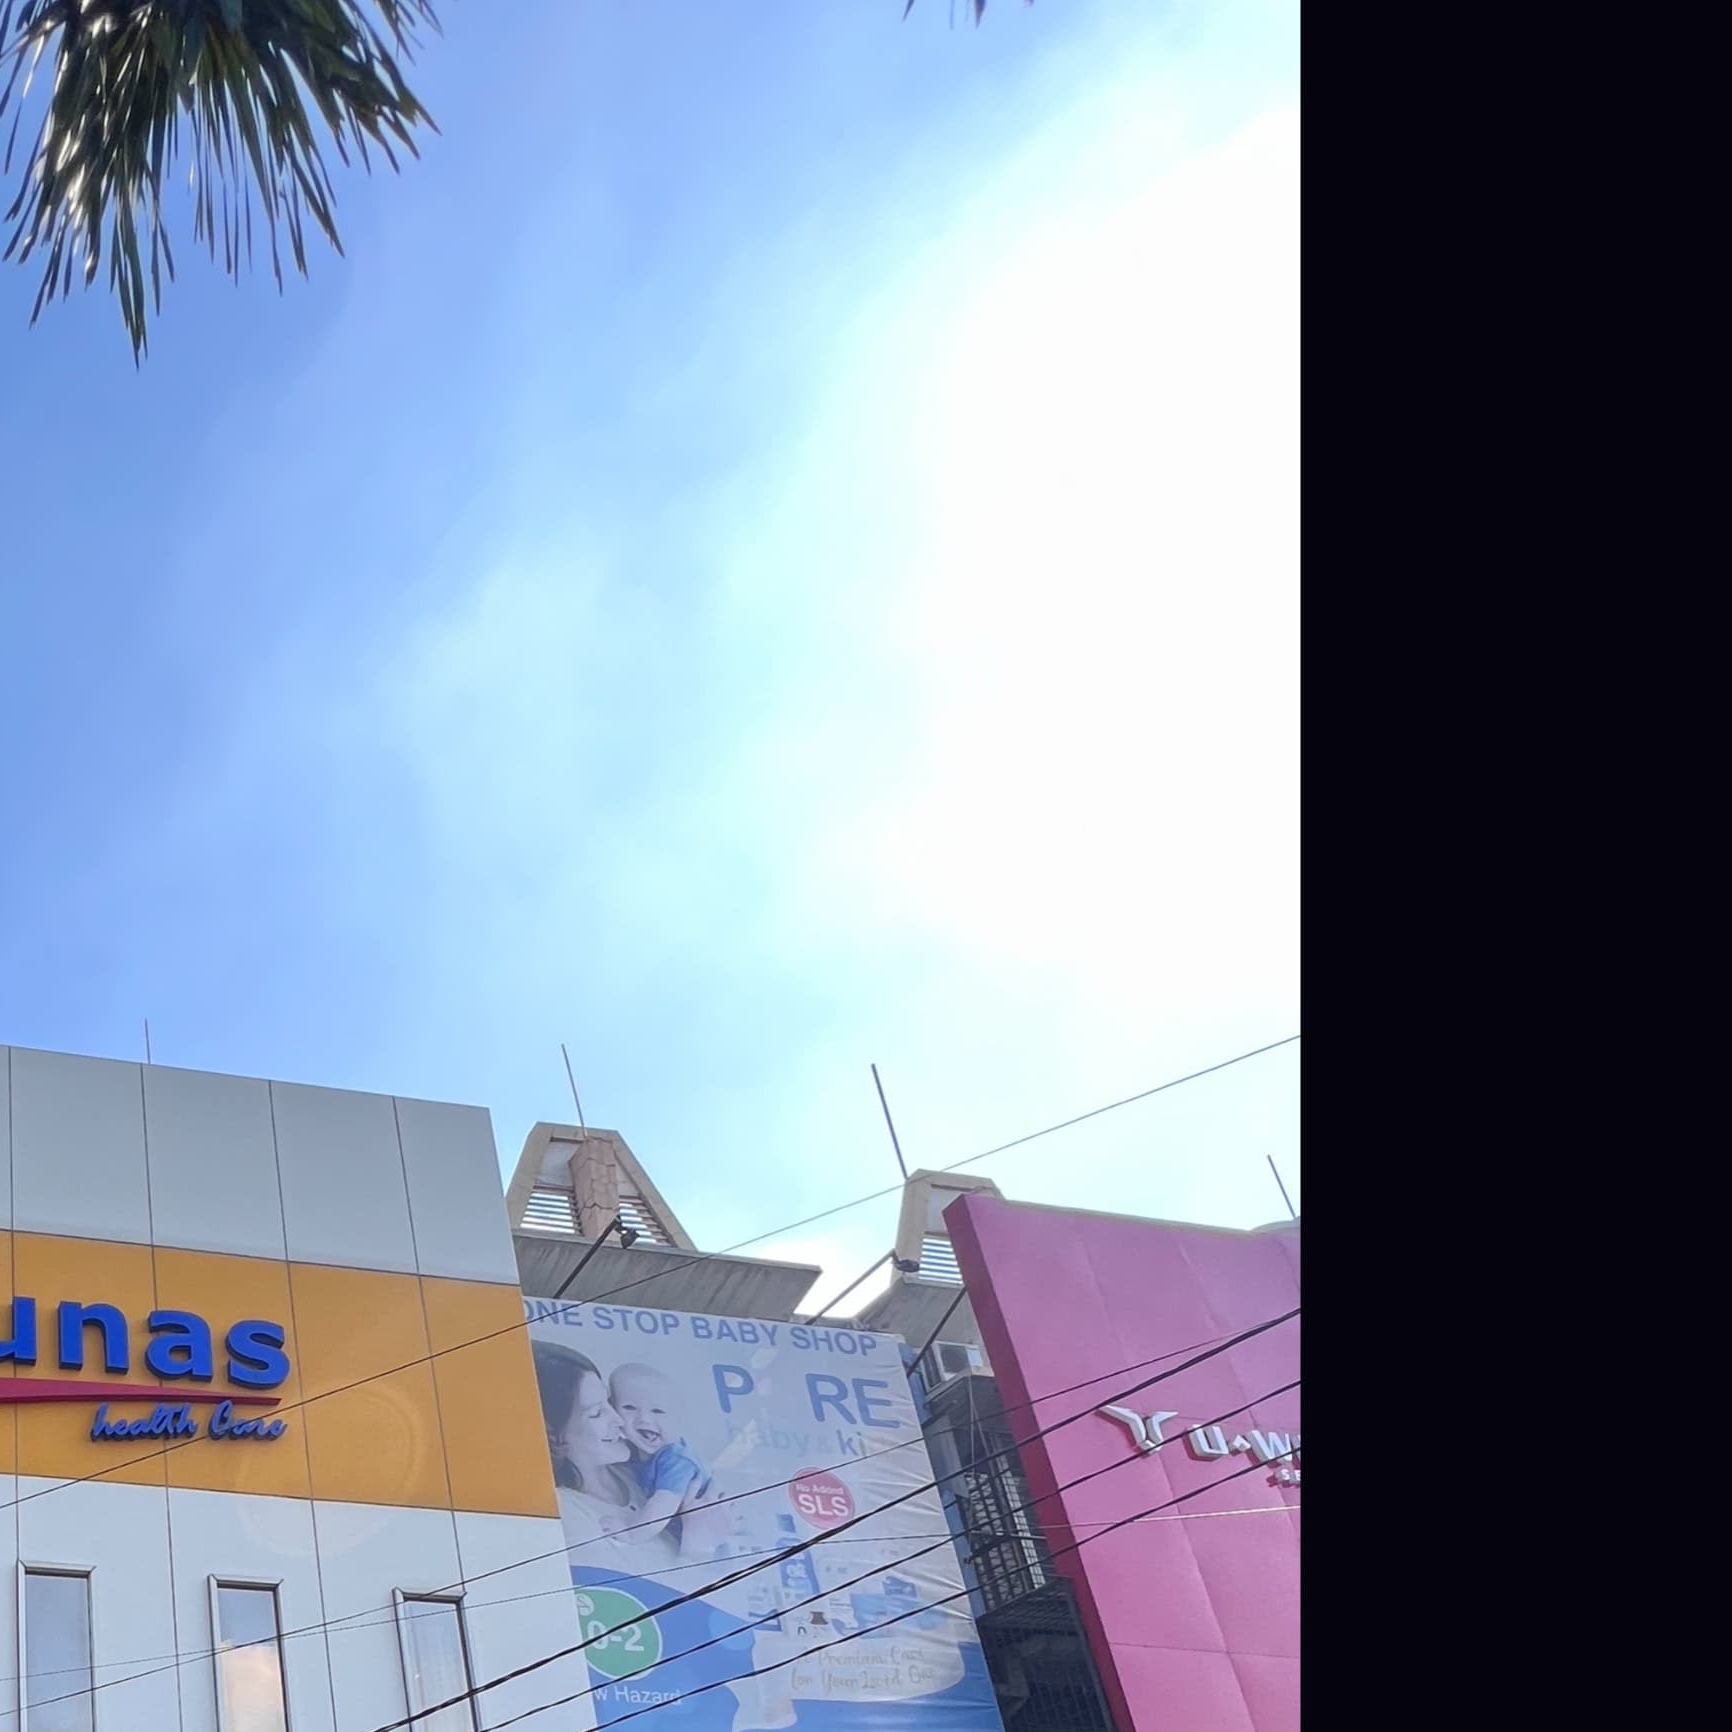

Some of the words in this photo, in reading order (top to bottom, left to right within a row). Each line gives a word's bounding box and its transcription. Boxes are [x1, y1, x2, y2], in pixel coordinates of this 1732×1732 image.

[593, 1306, 680, 1335] STOP
[691, 1316, 778, 1346] BABY
[789, 1327, 876, 1356] SHOP
[798, 1494, 849, 1517] SLS
